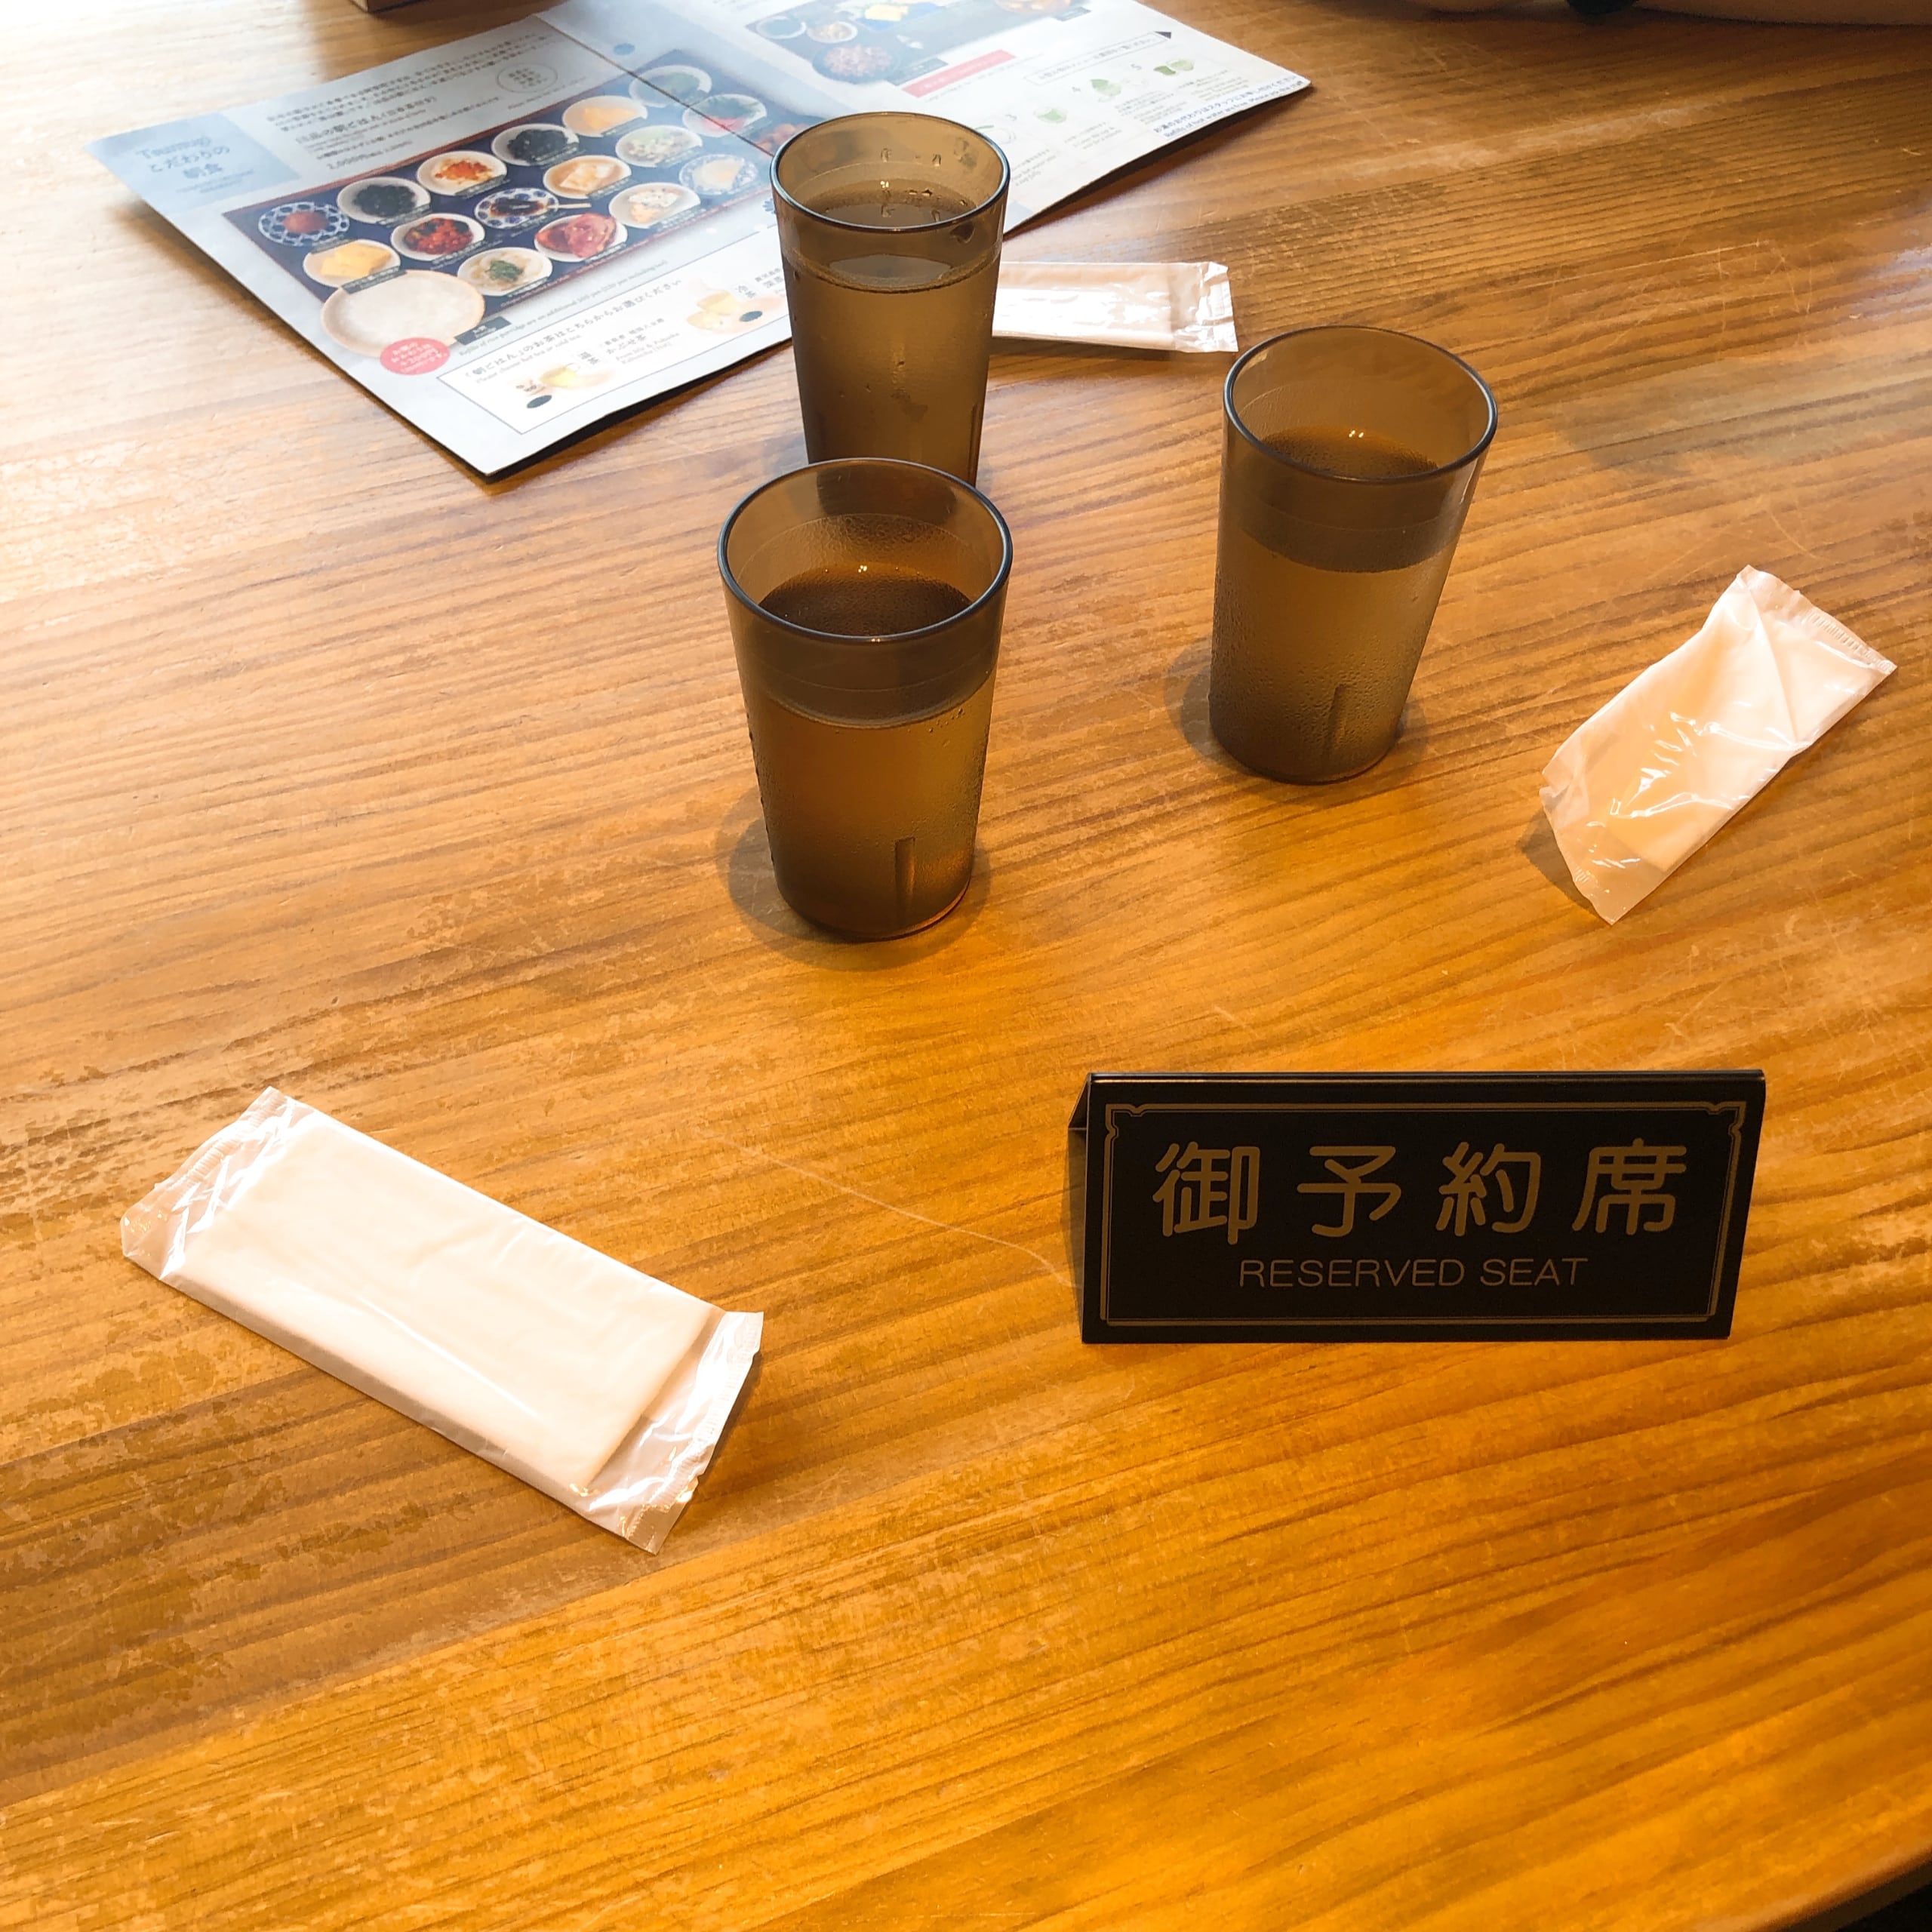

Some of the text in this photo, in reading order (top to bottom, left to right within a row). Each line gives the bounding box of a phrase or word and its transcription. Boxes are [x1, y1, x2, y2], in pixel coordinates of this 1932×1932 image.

[1152, 1137, 1687, 1245] 御予約席
[1238, 1257, 1589, 1287] RESERVED SEAT
